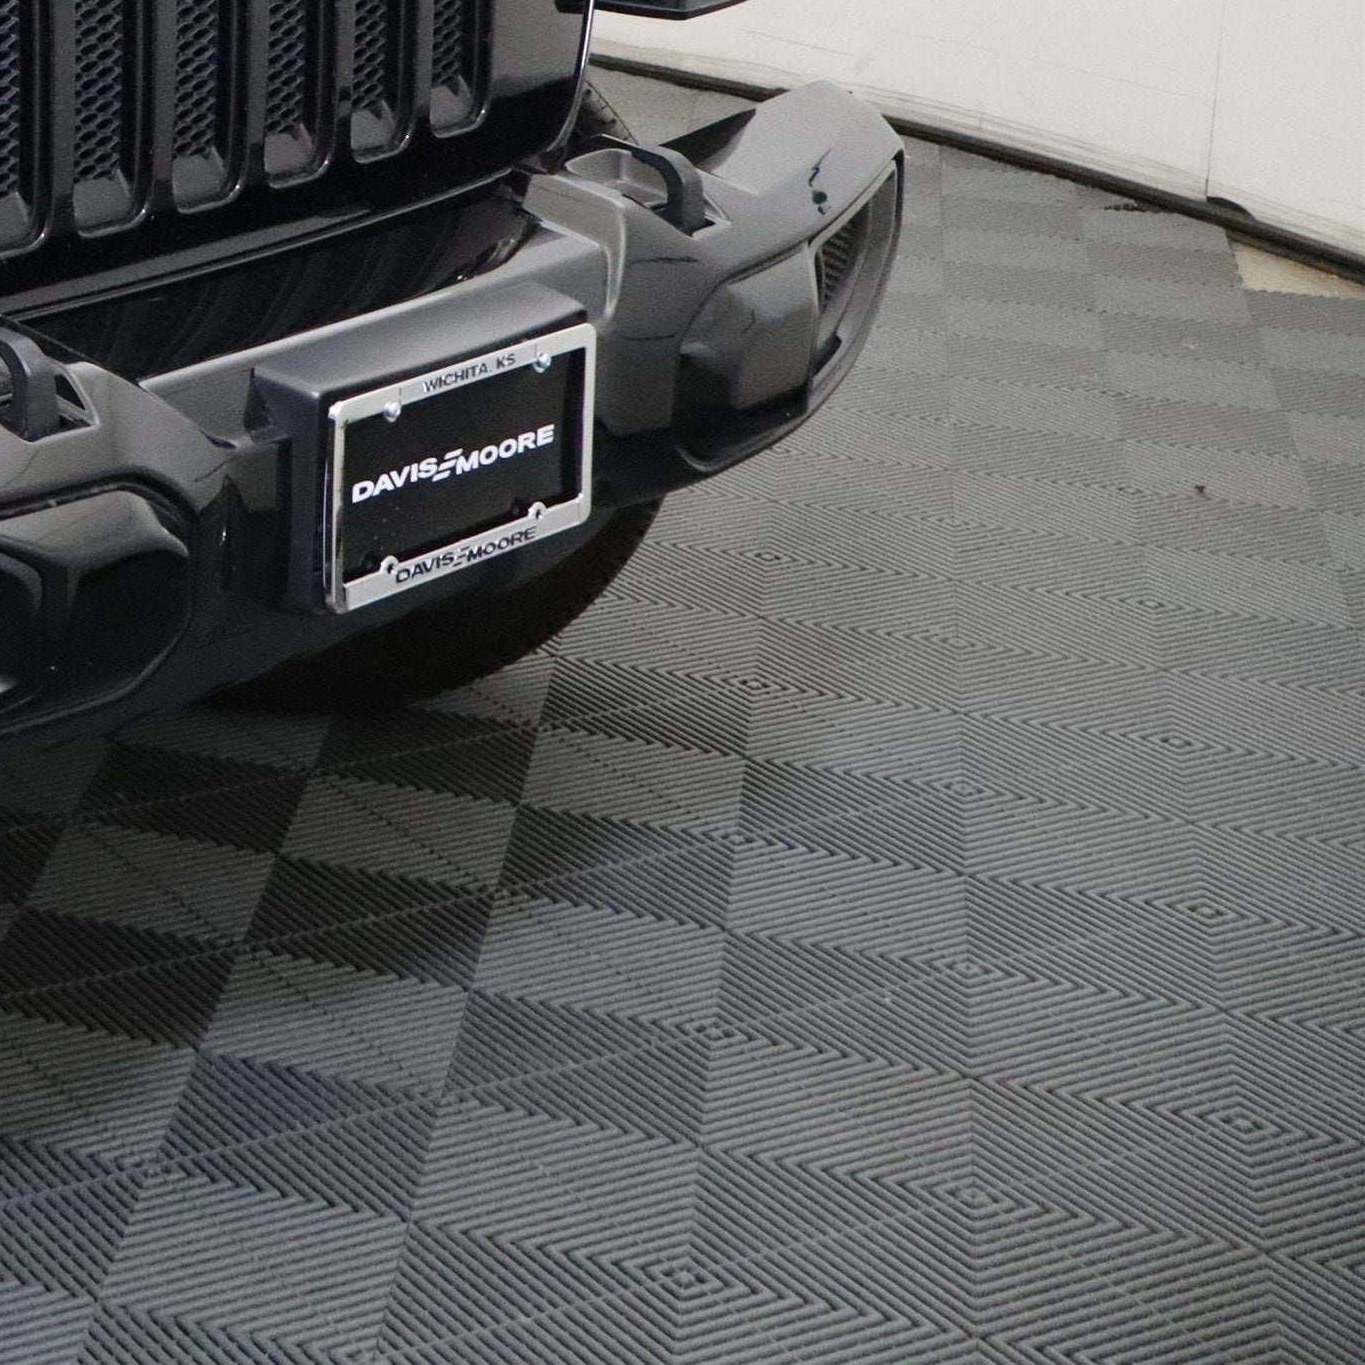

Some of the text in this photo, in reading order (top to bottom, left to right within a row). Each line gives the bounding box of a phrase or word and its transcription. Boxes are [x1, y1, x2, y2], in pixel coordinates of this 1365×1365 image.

[496, 353, 516, 369] KS
[352, 424, 555, 504] DAVIS MOORE
[396, 526, 537, 584] DAVIS MOORE
